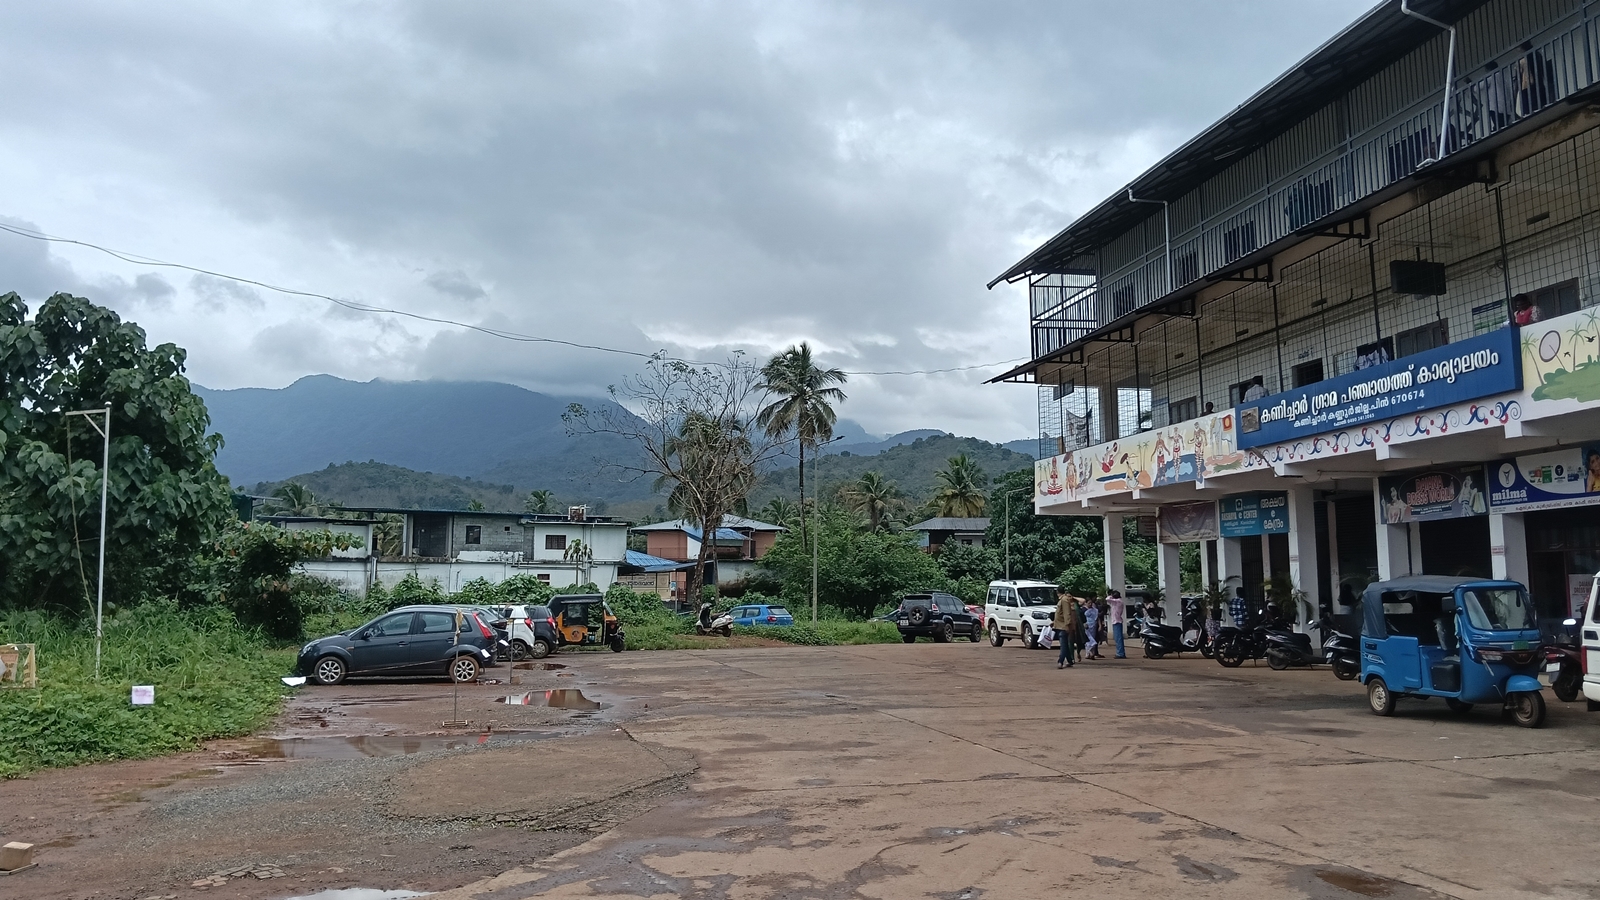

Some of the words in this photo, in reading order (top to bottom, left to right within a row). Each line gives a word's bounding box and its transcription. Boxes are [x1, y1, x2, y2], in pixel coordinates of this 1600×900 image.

[1260, 394, 1308, 423] കണിച്ചാർ
[1311, 391, 1338, 416] ഗ്രാമ
[1341, 363, 1415, 404] പഞ്ചായത്ത്
[1417, 348, 1499, 384] കാര്യാലയം
[1391, 389, 1425, 405] 670674
[1492, 488, 1527, 501] milma
